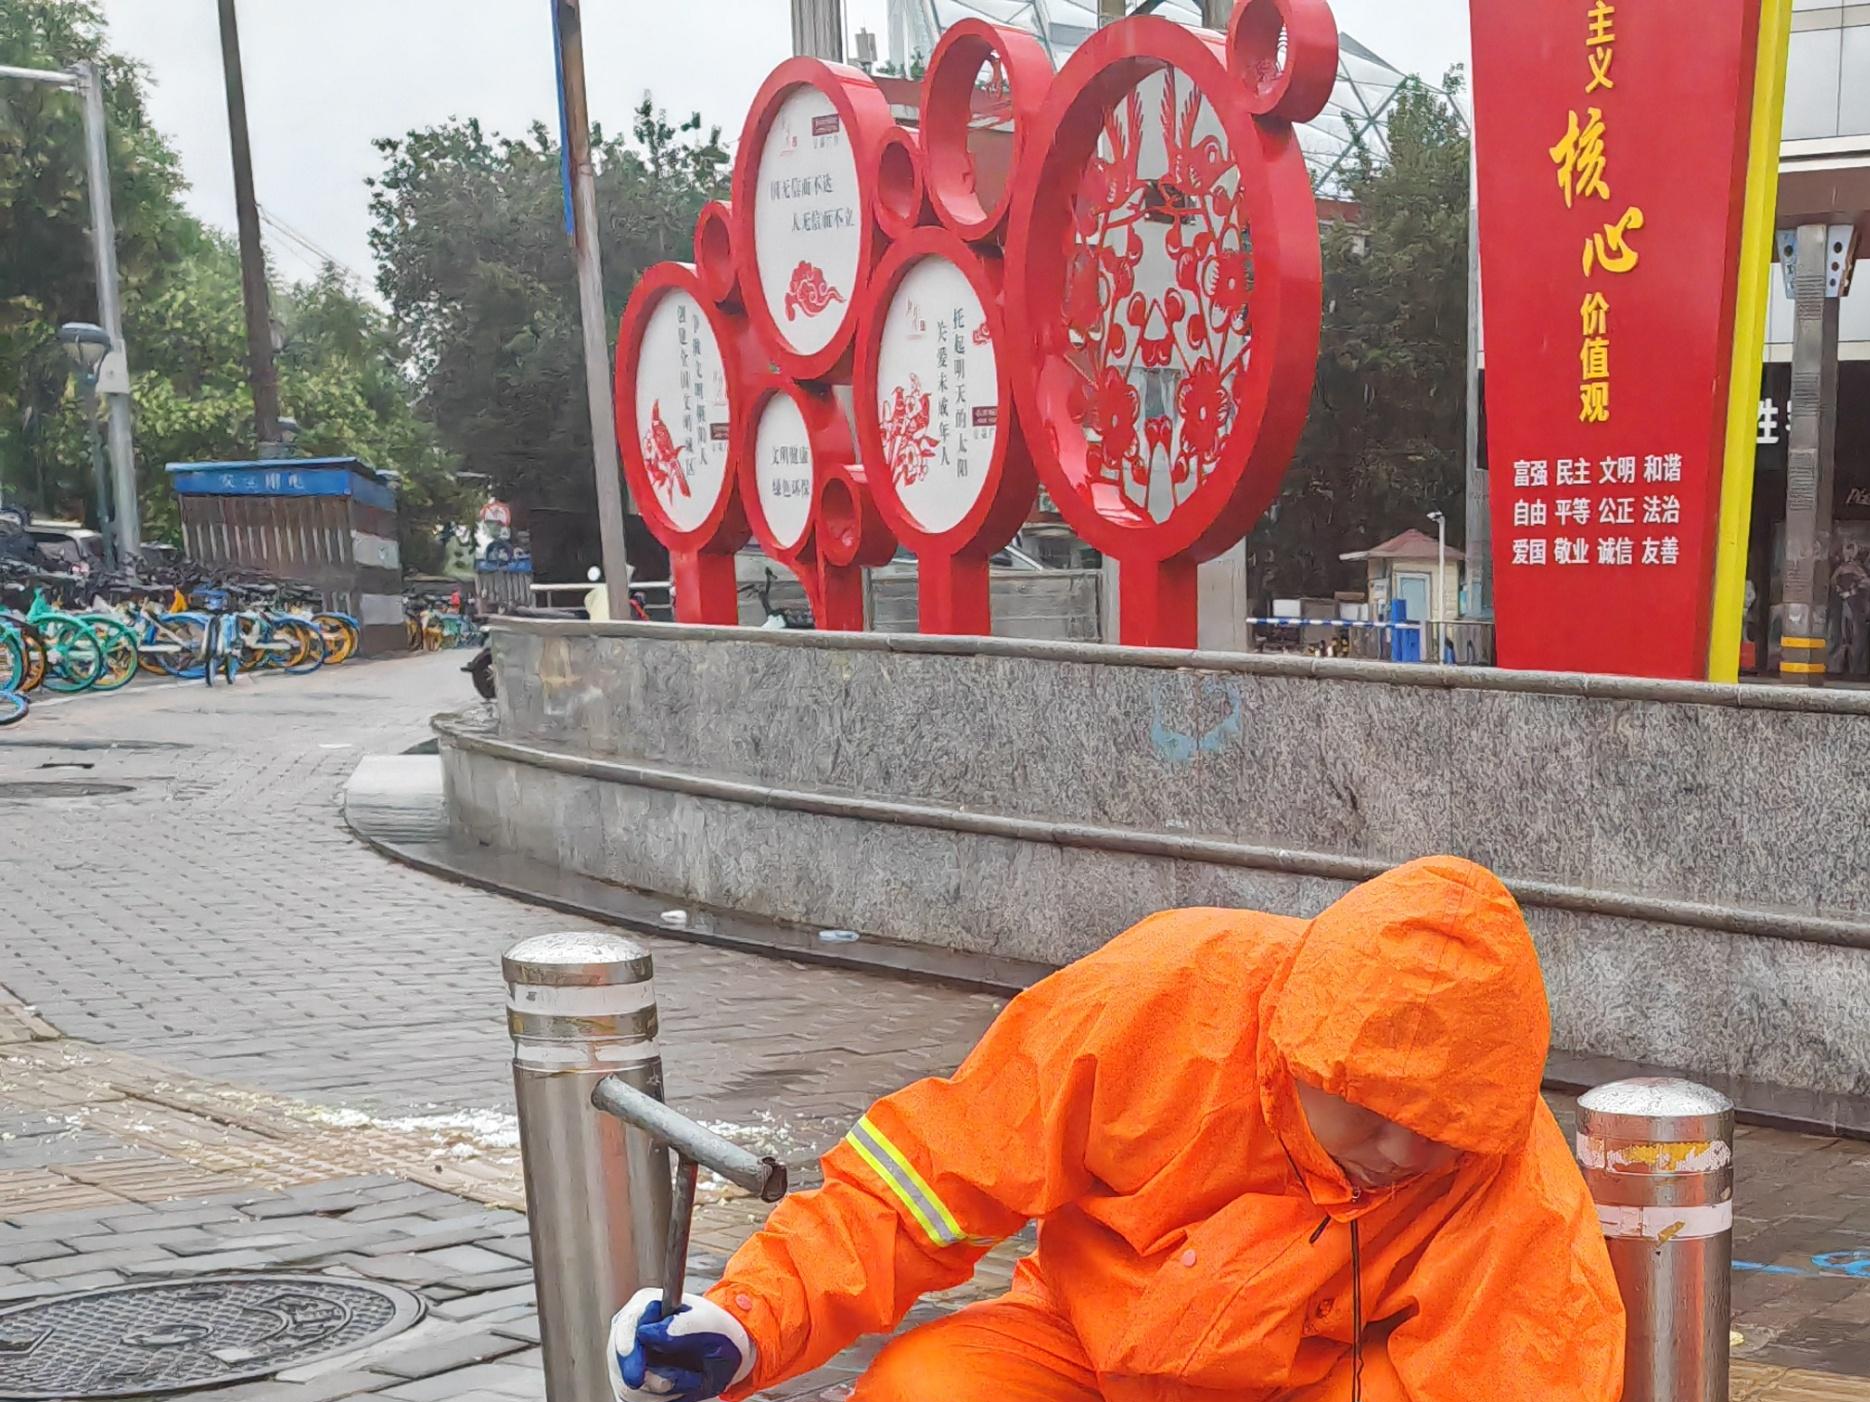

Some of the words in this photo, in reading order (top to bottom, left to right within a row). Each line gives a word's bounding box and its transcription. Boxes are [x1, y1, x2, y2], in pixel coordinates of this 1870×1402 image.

[936, 320, 950, 467] 关爱未成年人
[953, 308, 968, 478] 托起明天的太阳
[1513, 459, 1549, 487] 富强
[1556, 457, 1591, 486] 民主
[1599, 455, 1636, 484] 文明
[1643, 453, 1682, 483] 和谐
[1514, 498, 1547, 526] 自由
[1555, 497, 1591, 526] 平等
[1598, 497, 1635, 525] 公正
[1643, 494, 1681, 524] 法治
[1512, 538, 1547, 565] 爱国
[1554, 537, 1590, 565] 敬业
[1597, 536, 1634, 565] 诚信
[1641, 536, 1680, 565] 友善
